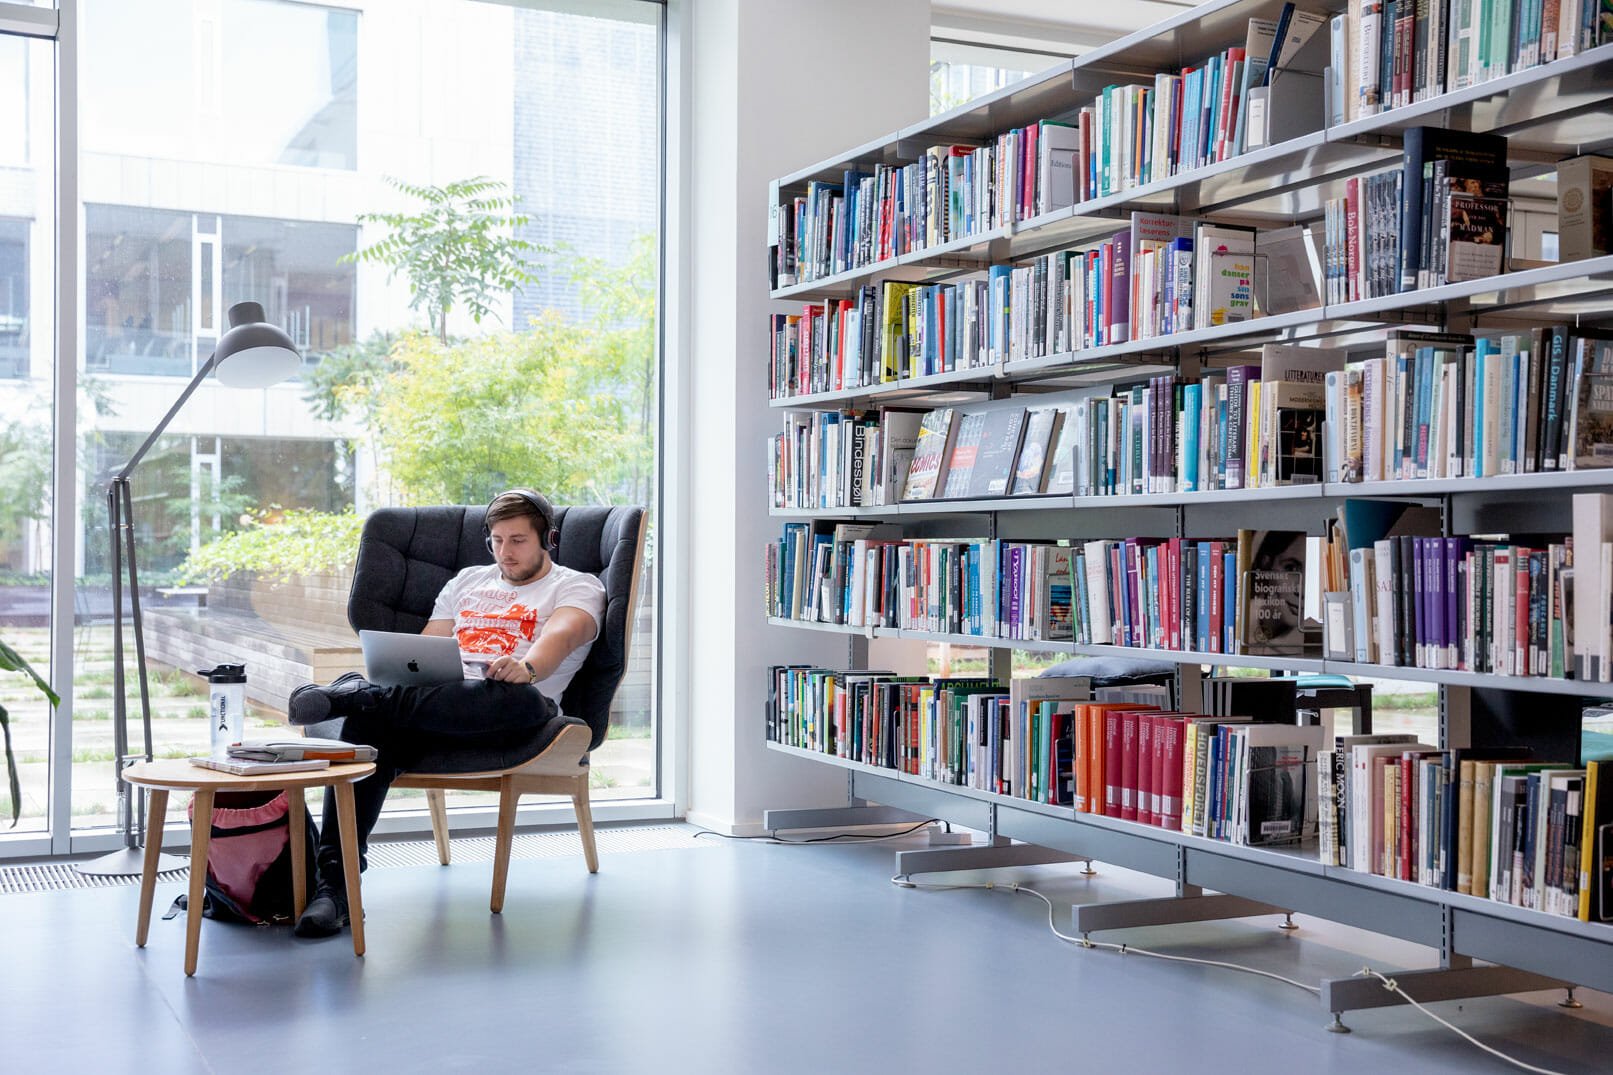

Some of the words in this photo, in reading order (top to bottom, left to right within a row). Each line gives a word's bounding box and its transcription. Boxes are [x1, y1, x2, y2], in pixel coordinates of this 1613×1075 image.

[1455, 200, 1498, 212] PROFESSOR
[1459, 224, 1494, 233] MADMAN
[1553, 335, 1562, 354] GIS
[1548, 366, 1561, 421] Danmark
[1233, 411, 1238, 420] TO
[853, 426, 866, 503] Bindesbøll
[1186, 608, 1190, 616] OF
[1335, 747, 1344, 771] ERIC
[1194, 733, 1208, 827] HOVEDSPORET
[1336, 773, 1345, 809] MOON
